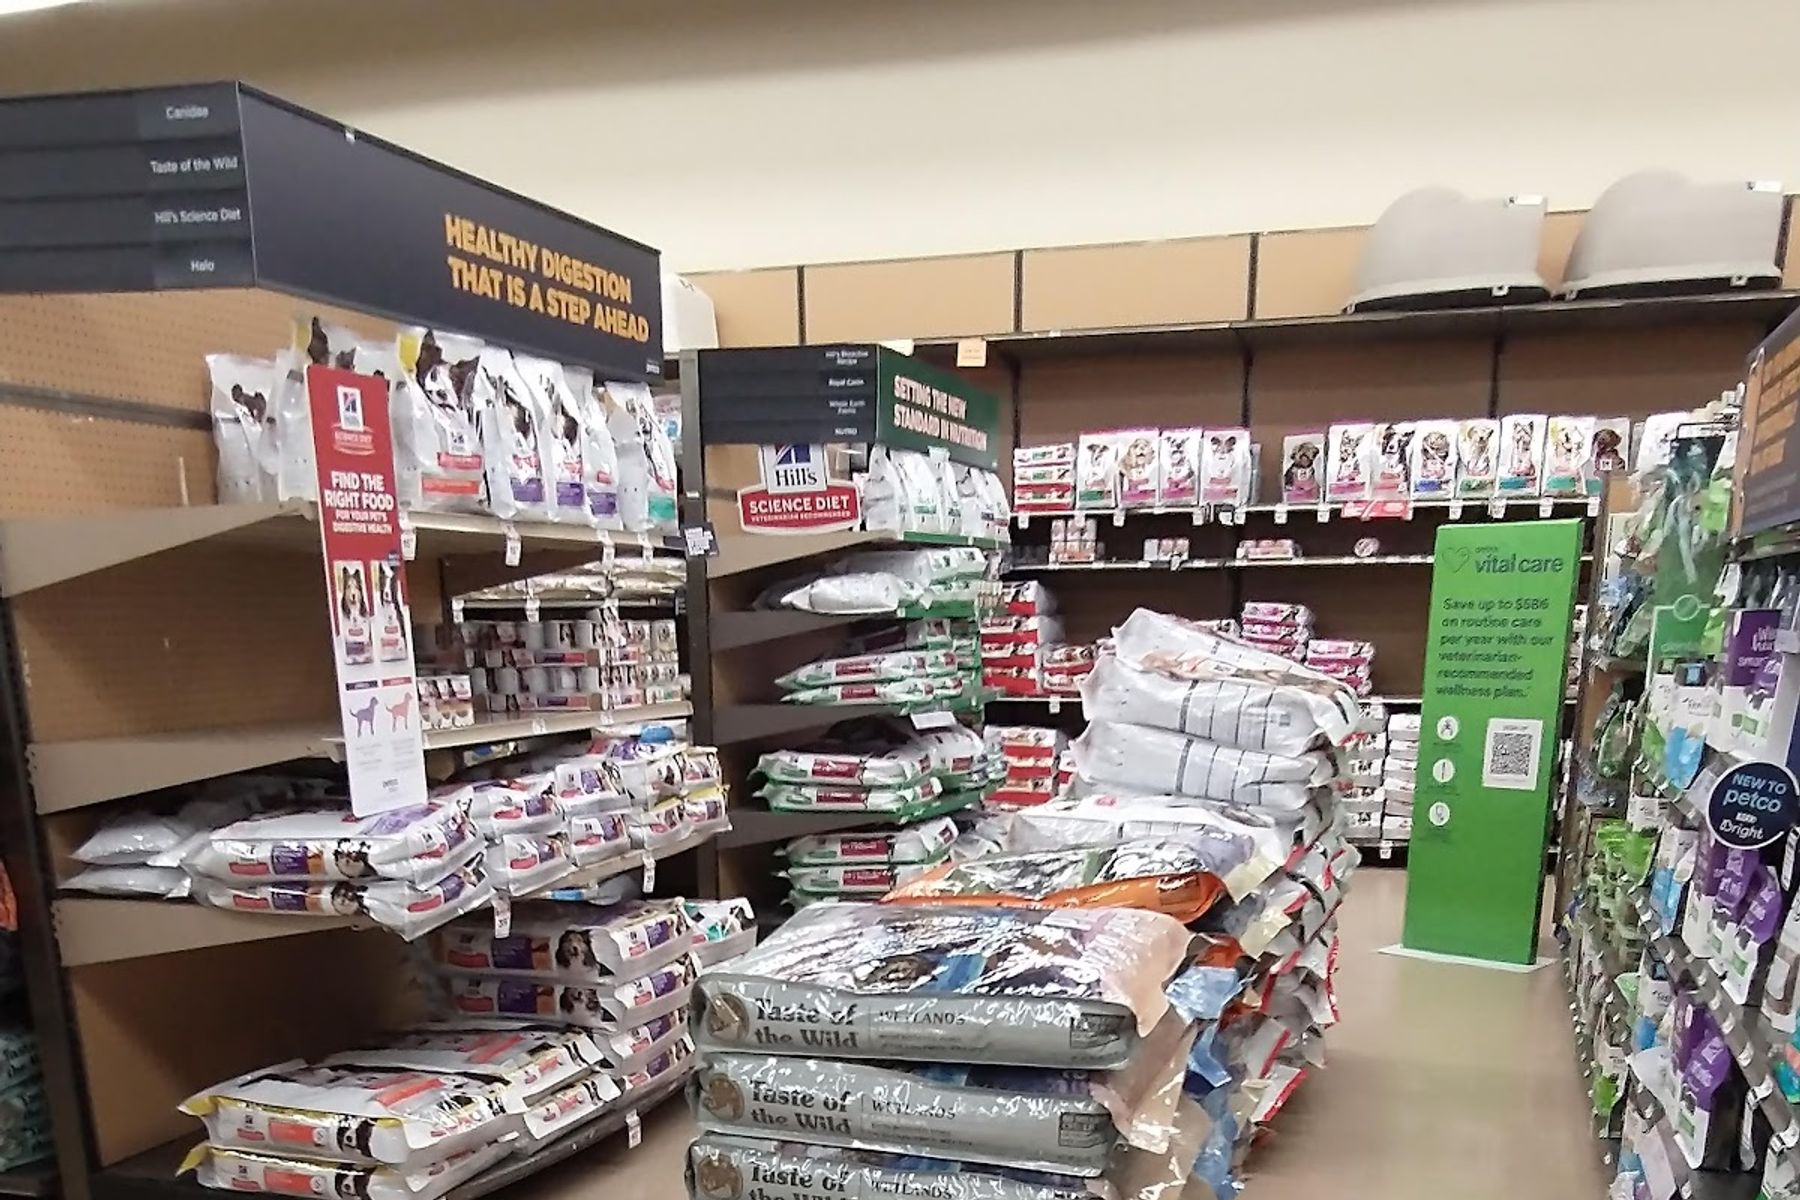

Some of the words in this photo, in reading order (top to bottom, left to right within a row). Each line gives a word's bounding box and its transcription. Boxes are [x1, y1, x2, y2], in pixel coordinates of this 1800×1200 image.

[150, 160, 178, 174] Taste
[180, 159, 191, 172] of
[193, 158, 211, 171] the
[213, 156, 238, 170] Wild
[180, 209, 218, 223] Science
[220, 207, 241, 221] Diet
[191, 260, 215, 272] Halo
[444, 214, 539, 273] HEALTHY
[541, 247, 632, 304] DIGESTION
[447, 256, 503, 300] THAT
[507, 274, 525, 307] IS
[529, 282, 544, 313] A
[547, 288, 591, 325] STEP
[594, 303, 649, 343] AHEAD
[894, 375, 932, 408] SETTING
[932, 386, 948, 414] THE
[948, 394, 967, 420] NEW
[894, 403, 940, 438] STANDARD
[940, 418, 950, 440] IN
[331, 470, 360, 490] FIND
[360, 472, 385, 492] THE
[775, 467, 818, 487] Hill's
[324, 489, 360, 509] RIGHT
[362, 492, 394, 512] FOOD
[749, 497, 813, 515] SCIENCE
[815, 494, 850, 510] DIET
[335, 510, 350, 522] FOR
[350, 511, 369, 523] YOUR
[367, 523, 393, 535] HEALTH
[1475, 553, 1517, 574] vital
[1518, 557, 1565, 574] care
[1443, 598, 1475, 611] Save
[1478, 600, 1495, 613] up
[1498, 599, 1513, 610] to
[1441, 617, 1459, 627] on
[1460, 614, 1509, 627] routine
[1511, 617, 1542, 628] care
[1440, 635, 1462, 646] per
[1466, 635, 1492, 647] year
[1497, 633, 1527, 646] with
[1530, 635, 1553, 646] our
[1439, 651, 1522, 663] veterinarian-
[1437, 668, 1534, 681] recommended
[1437, 684, 1491, 697] wellness
[1732, 773, 1766, 790] NEW
[1768, 780, 1787, 795] TO
[1722, 789, 1781, 813] petco
[1719, 819, 1764, 839] Bright
[755, 998, 821, 1024] Taste
[830, 1003, 858, 1026] of
[879, 1010, 966, 1026] WELANDS
[754, 1026, 792, 1045] the
[800, 1028, 859, 1048] Wild
[750, 1079, 815, 1109] Taste
[823, 1091, 851, 1112] of
[872, 1098, 956, 1120] WETLDS
[751, 1108, 788, 1125] the
[794, 1112, 851, 1134] Wild
[751, 1163, 813, 1188] Taste
[822, 1168, 849, 1192] of
